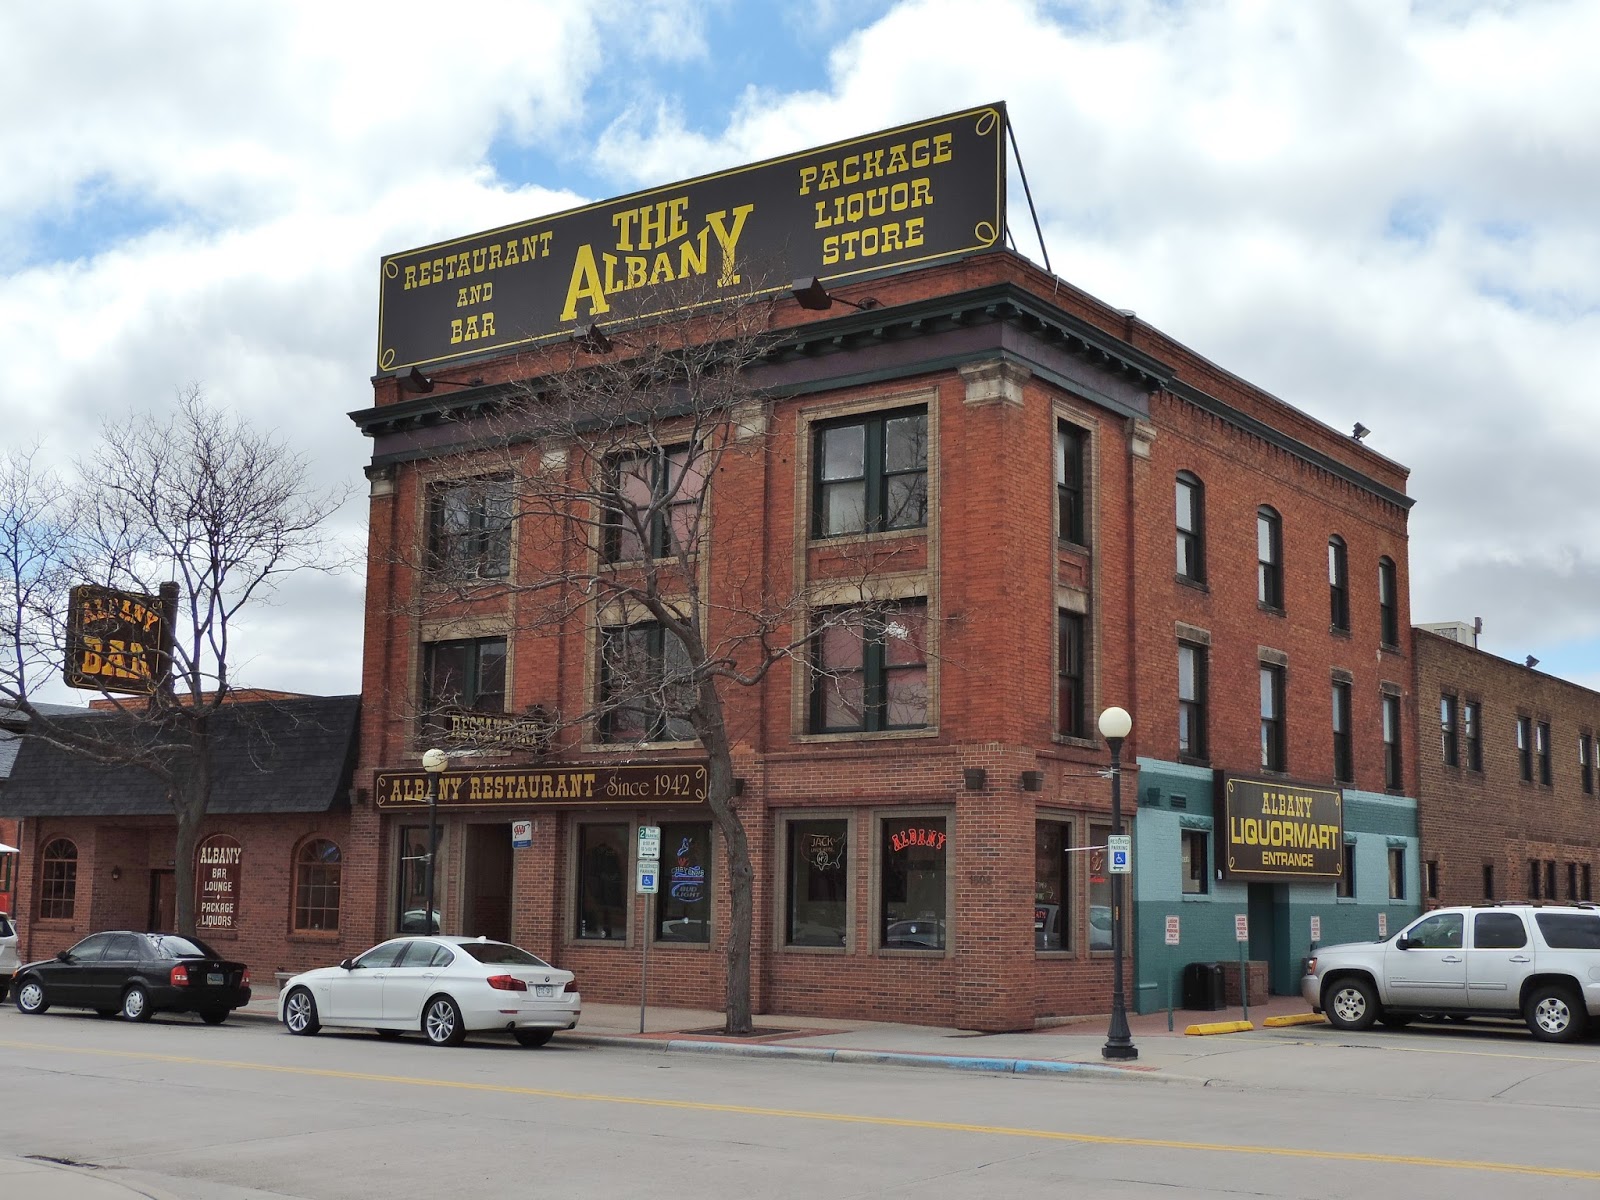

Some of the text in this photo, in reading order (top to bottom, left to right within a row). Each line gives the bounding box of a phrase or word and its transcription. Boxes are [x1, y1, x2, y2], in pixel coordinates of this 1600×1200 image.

[799, 133, 952, 196] PACKAGE
[815, 177, 934, 230] LIQUOR
[612, 196, 689, 252] THE
[822, 217, 924, 265] STORE
[404, 231, 553, 290] RESTAURANT
[560, 204, 754, 322] ALBANY
[457, 282, 493, 308] AND
[450, 312, 496, 344] BAR
[81, 634, 152, 680] BAR
[470, 774, 596, 799] RESTAURANT
[606, 775, 649, 796] Since
[653, 774, 690, 796] 1942
[1261, 792, 1312, 818] ALBANY
[640, 828, 646, 839] 2
[892, 829, 946, 851] ALBANY
[1231, 816, 1339, 850] LIQUORMART
[200, 847, 242, 864] ALBANY
[1262, 851, 1314, 867] ENTRANCE
[204, 881, 232, 892] LOUNGE
[212, 868, 227, 880] BAR
[201, 902, 234, 913] PACKAGE
[201, 915, 232, 927] LIQUORS
